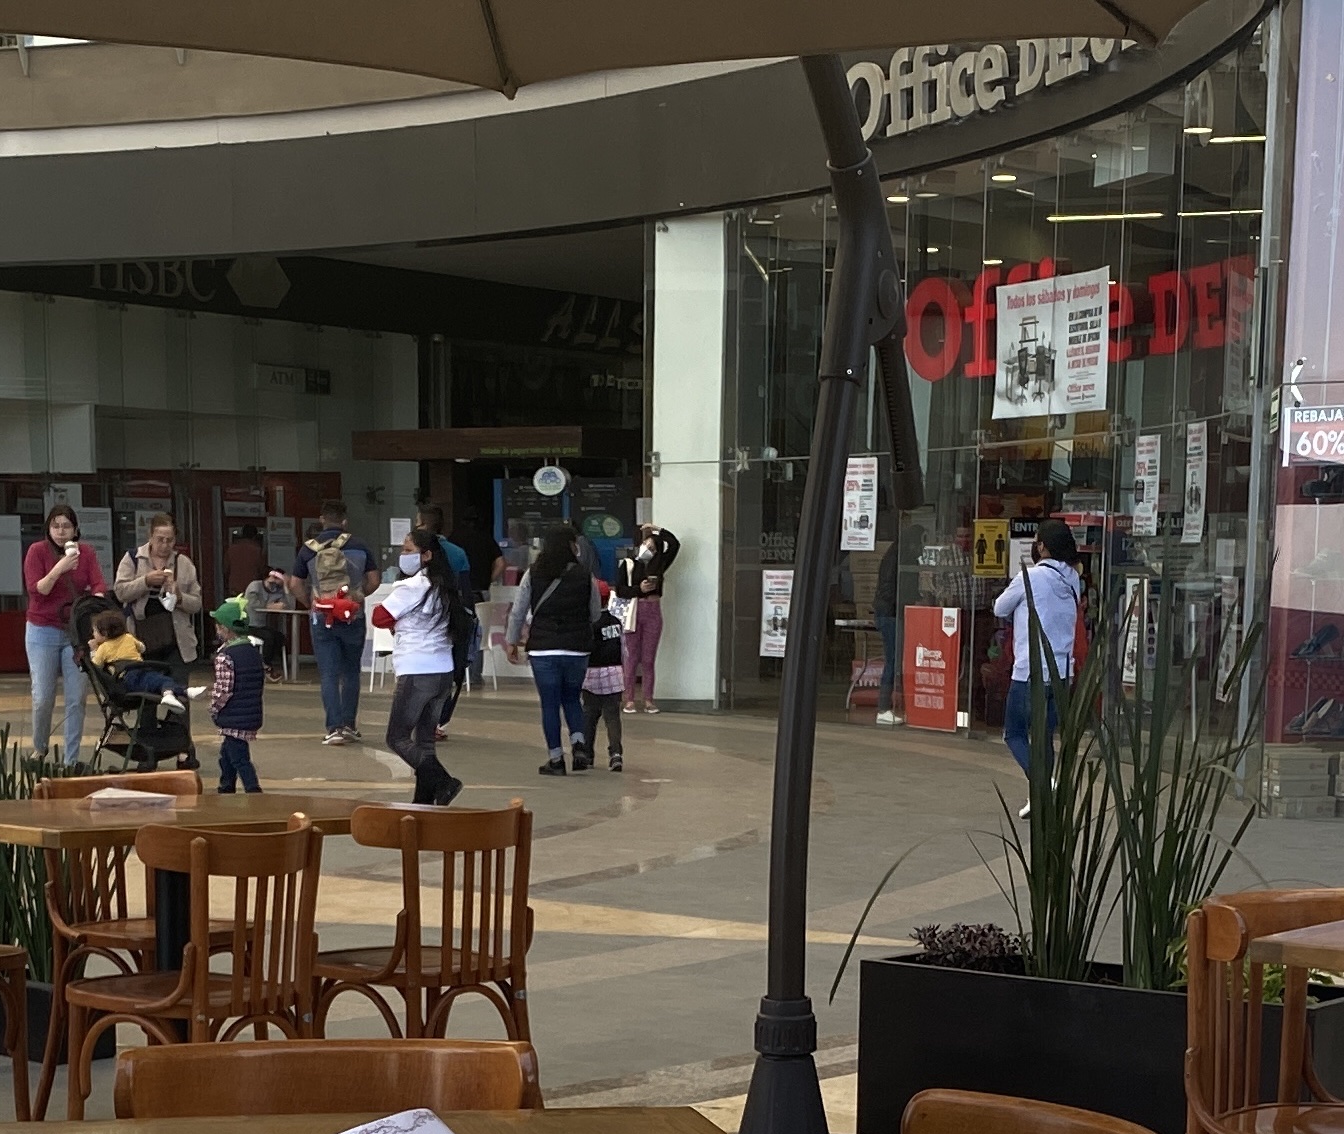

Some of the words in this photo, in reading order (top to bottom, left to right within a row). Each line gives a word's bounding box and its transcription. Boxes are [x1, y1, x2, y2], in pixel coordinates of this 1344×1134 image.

[846, 43, 1009, 142] Office
[90, 258, 216, 302] HSBC
[1007, 294, 1025, 310] Todos
[1026, 292, 1036, 307] los
[1037, 288, 1066, 304] sábados
[1066, 287, 1073, 304] y
[1072, 281, 1101, 300] domingos
[270, 371, 295, 386] ATM
[759, 531, 795, 548] Office
[759, 548, 795, 561] DEPOT
